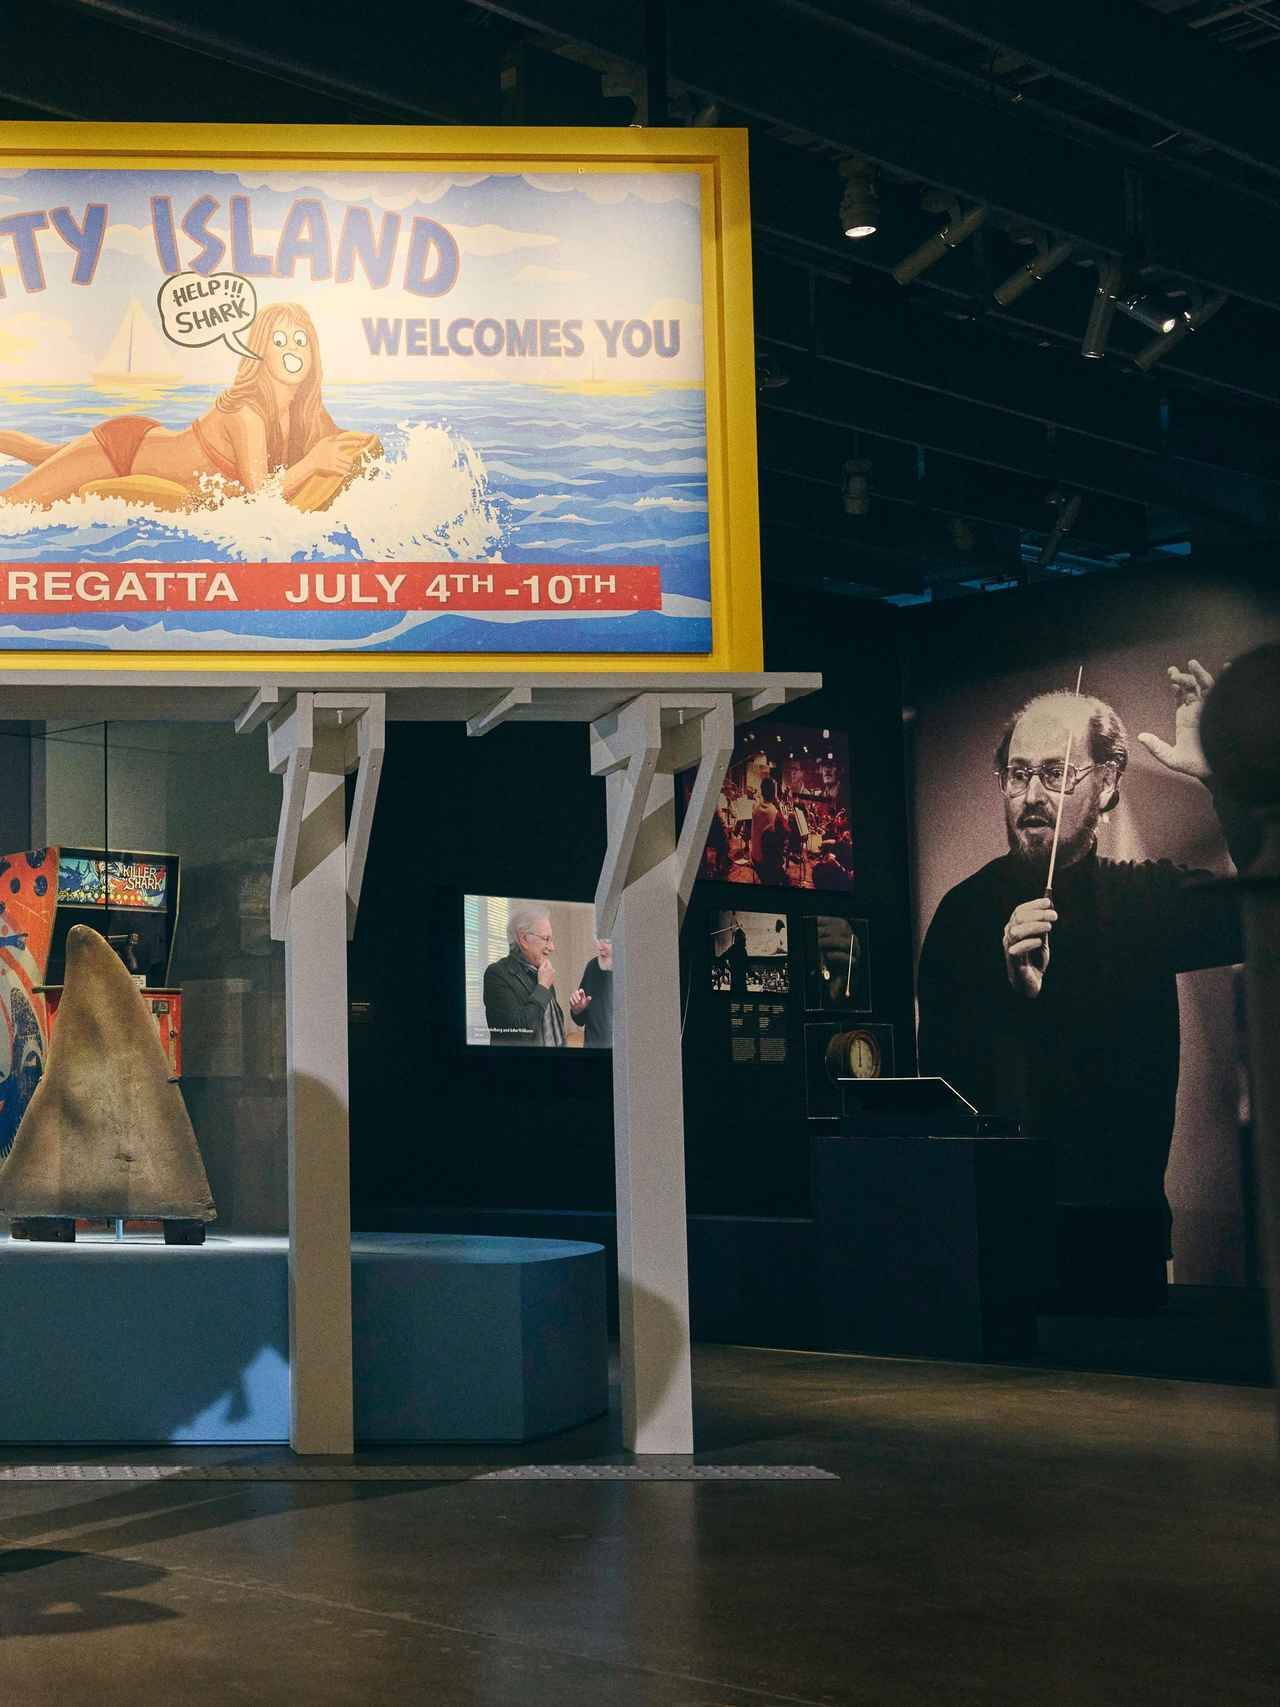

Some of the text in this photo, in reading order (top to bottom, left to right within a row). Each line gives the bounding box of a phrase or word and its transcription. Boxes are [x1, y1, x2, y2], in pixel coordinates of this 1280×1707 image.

[151, 195, 460, 298] ISLAND
[172, 279, 244, 307] HELP!!!
[175, 297, 250, 333] SHARK
[361, 317, 681, 359] WELCOMES YOU
[7, 571, 240, 602] REGATTA
[285, 572, 407, 604] JULY
[123, 864, 157, 878] KILLER
[124, 877, 161, 890] SHARK
